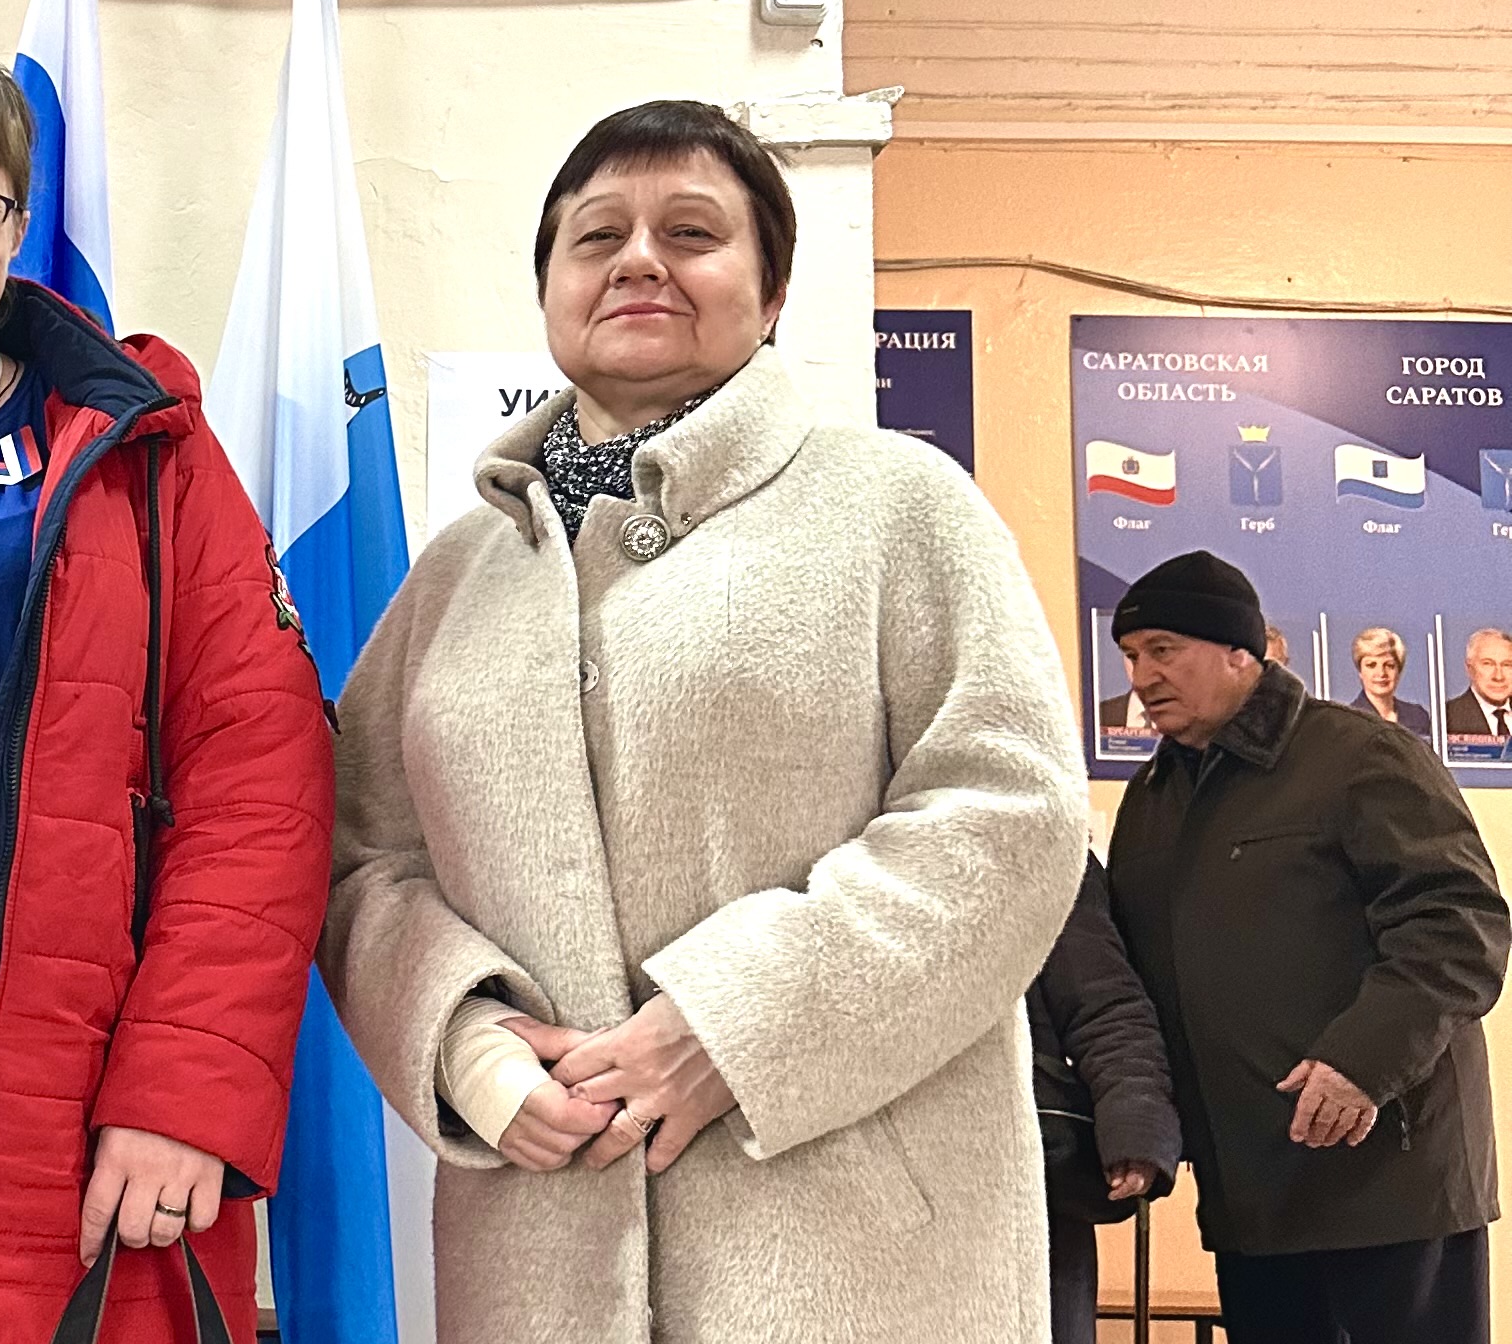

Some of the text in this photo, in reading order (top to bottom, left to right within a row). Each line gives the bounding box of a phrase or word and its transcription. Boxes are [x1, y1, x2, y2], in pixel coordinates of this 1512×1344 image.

[1082, 352, 1268, 373] САРАТОВСКАЯ
[1402, 357, 1486, 379] ГОРОД
[1117, 382, 1237, 402] ОБЛАСТЬ
[1386, 386, 1504, 406] САРАТОВ
[1113, 516, 1275, 533] Флаг Герб
[1363, 520, 1402, 533] Флаг
